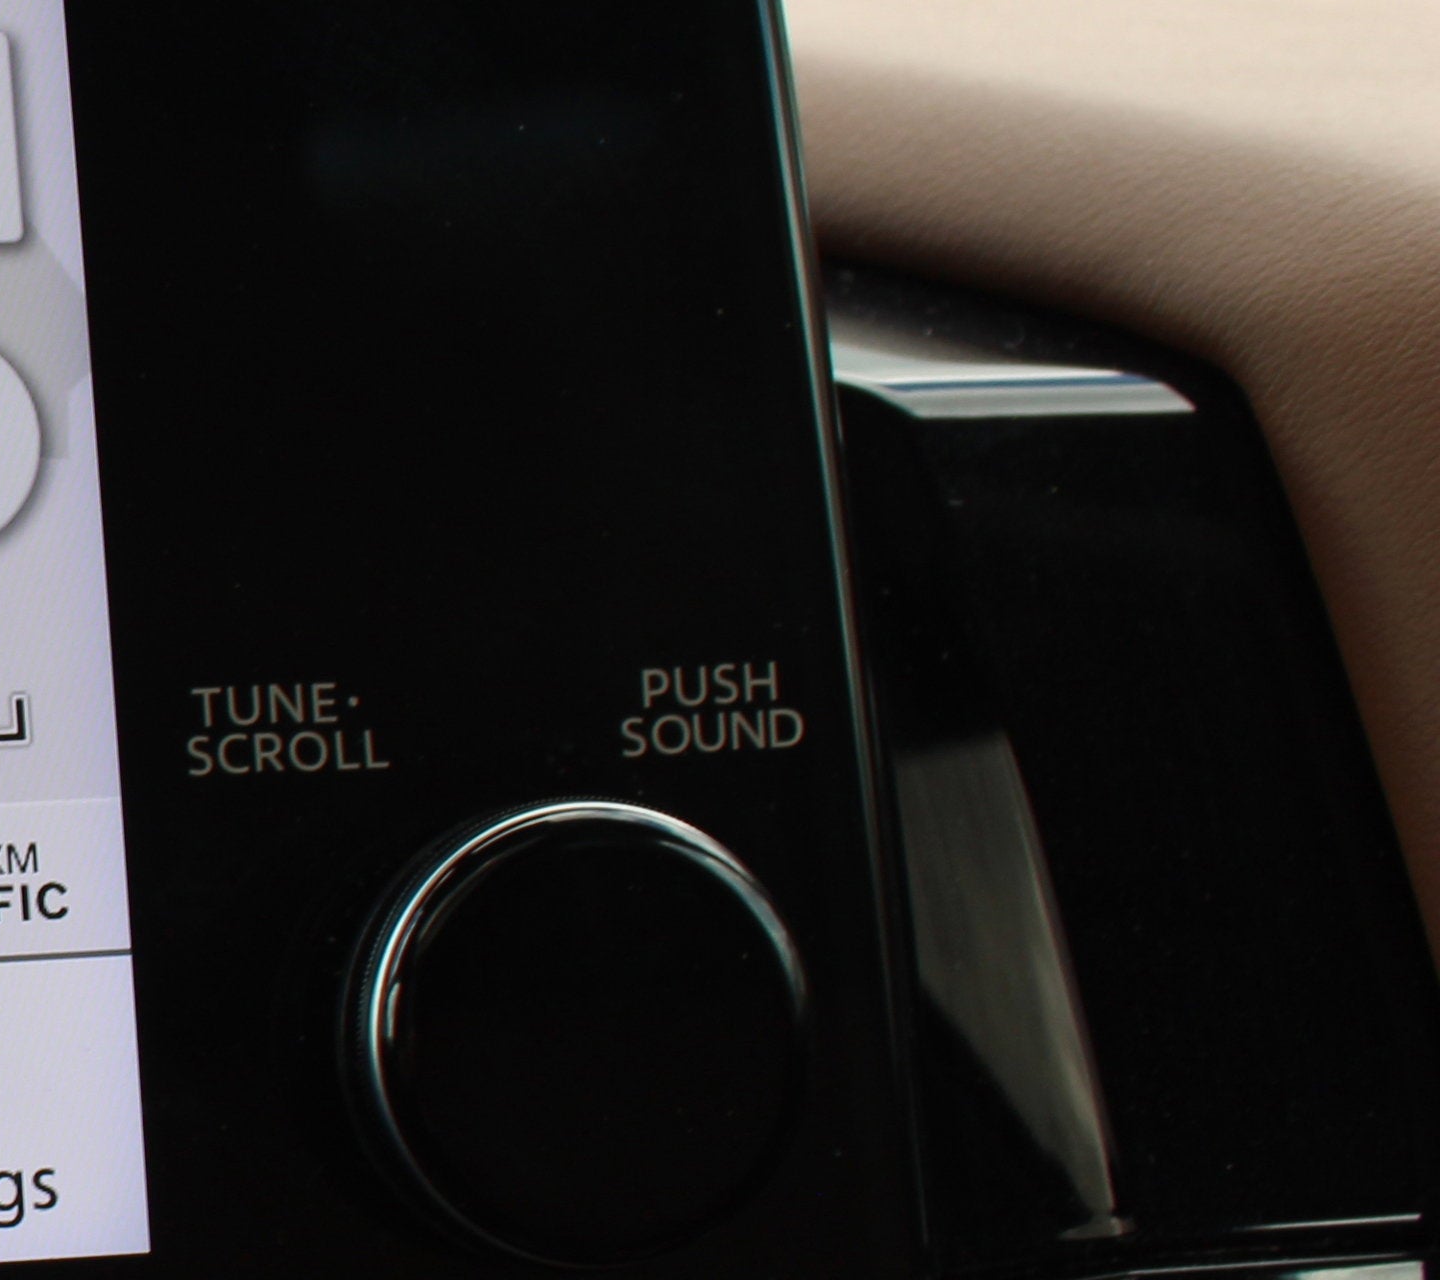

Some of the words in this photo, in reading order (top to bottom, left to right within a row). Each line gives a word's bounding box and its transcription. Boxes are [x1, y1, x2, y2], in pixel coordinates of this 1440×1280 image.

[641, 661, 779, 708] PUSH
[187, 730, 390, 776] SCROLL
[620, 708, 804, 758] SOUND
